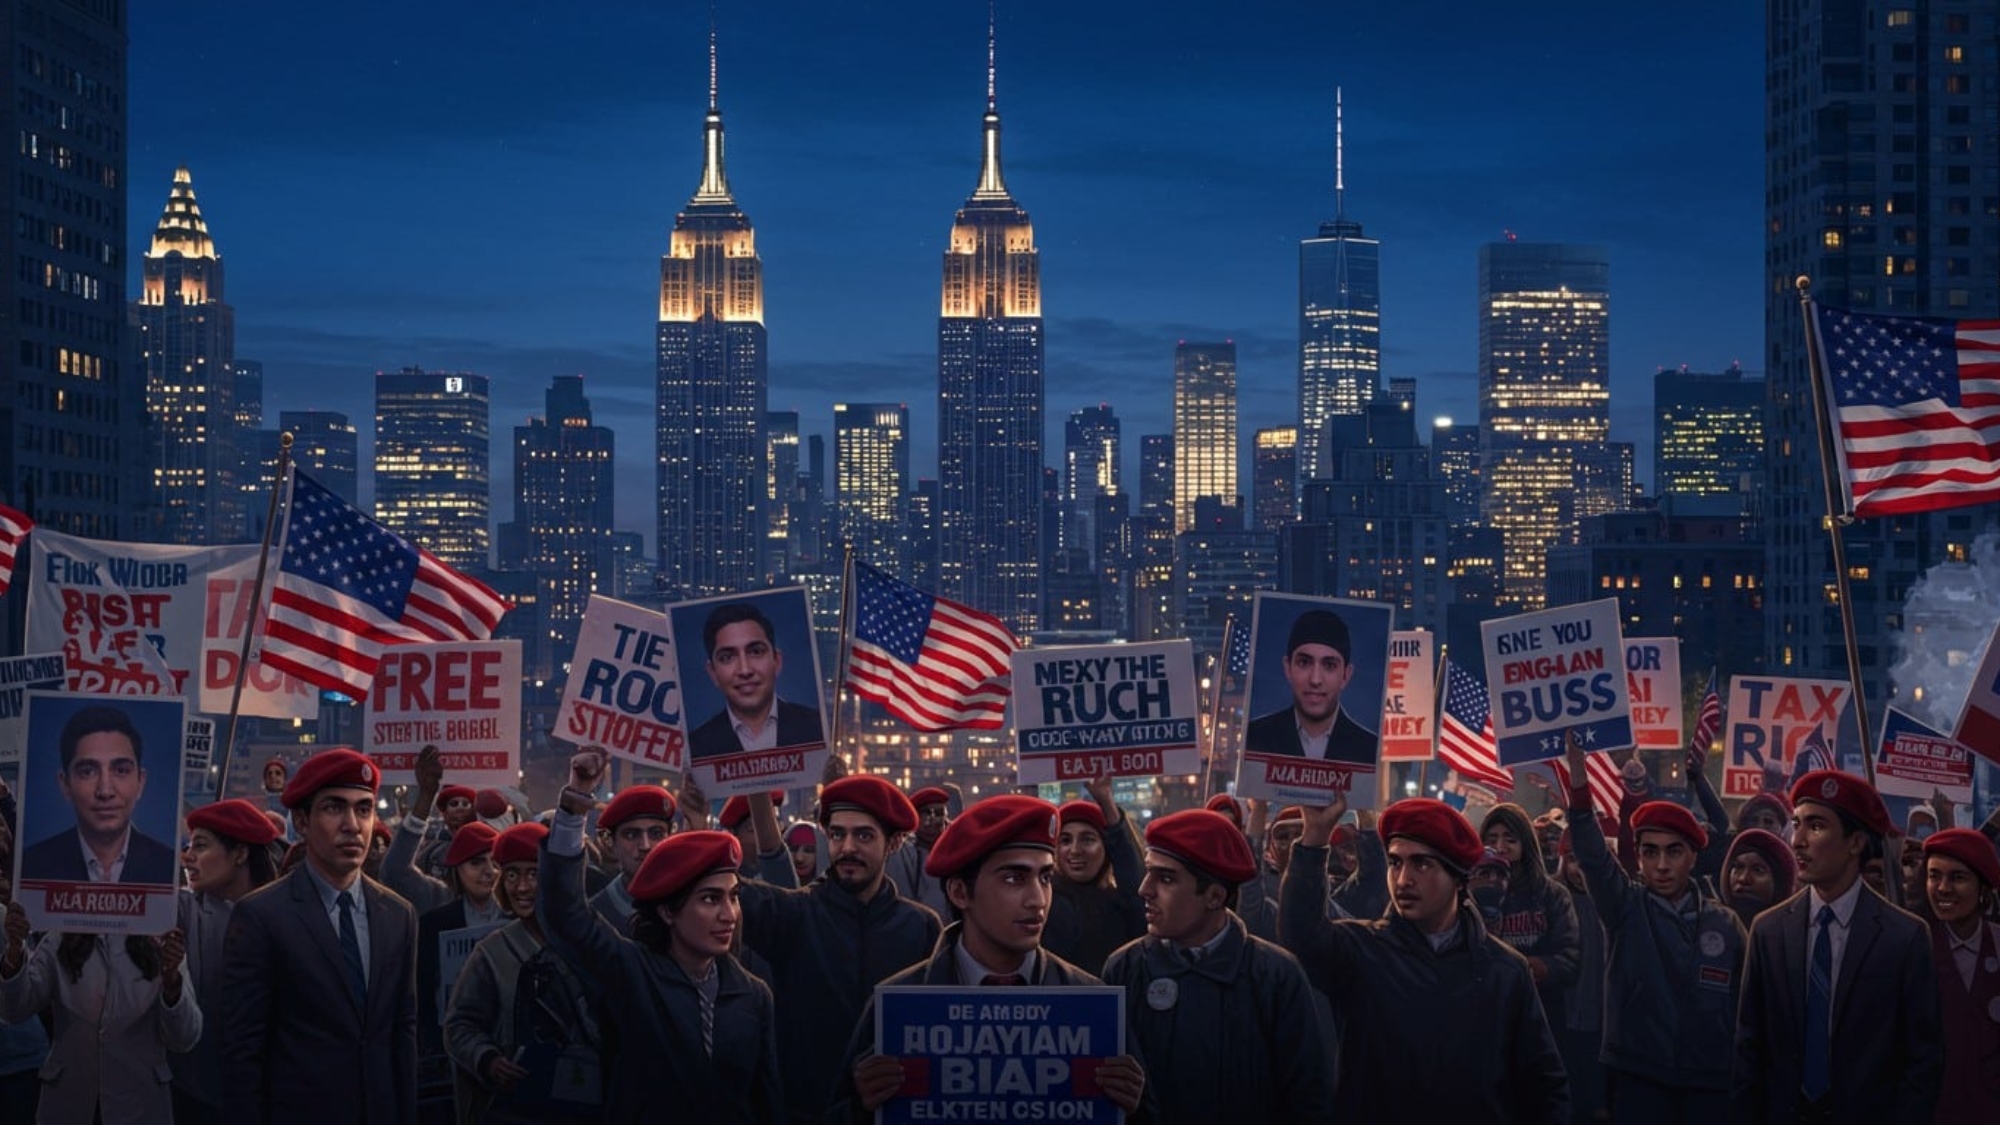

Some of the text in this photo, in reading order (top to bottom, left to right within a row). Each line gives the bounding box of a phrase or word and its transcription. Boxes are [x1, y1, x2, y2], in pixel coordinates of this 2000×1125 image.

[614, 624, 670, 671] TIE
[1552, 619, 1592, 646] YOU
[373, 651, 502, 713] FREE
[1114, 654, 1166, 681] THE
[1041, 680, 1171, 725] RUCH
[1501, 673, 1616, 729] BUSS
[1740, 679, 1845, 723] TAX
[941, 1057, 1070, 1096] BIAP
